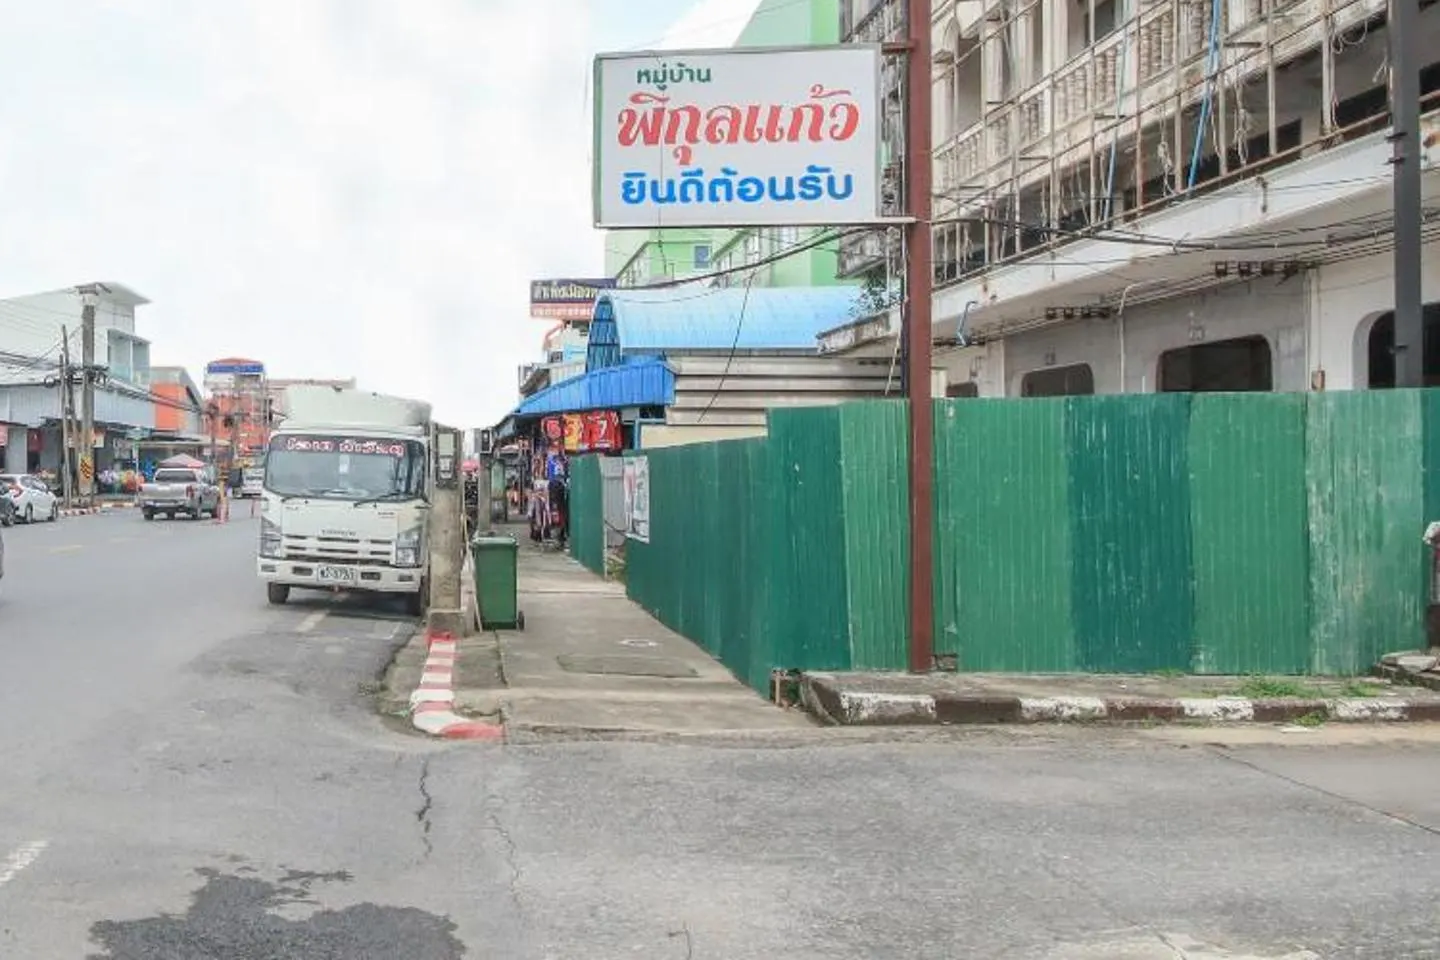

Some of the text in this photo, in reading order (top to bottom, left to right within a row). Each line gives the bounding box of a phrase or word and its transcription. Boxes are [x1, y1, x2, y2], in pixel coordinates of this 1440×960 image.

[636, 62, 712, 90] หมู่บ้าน
[617, 83, 860, 166] พิกุลแก้ว
[621, 164, 854, 205] ยินดีต้อนรับ
